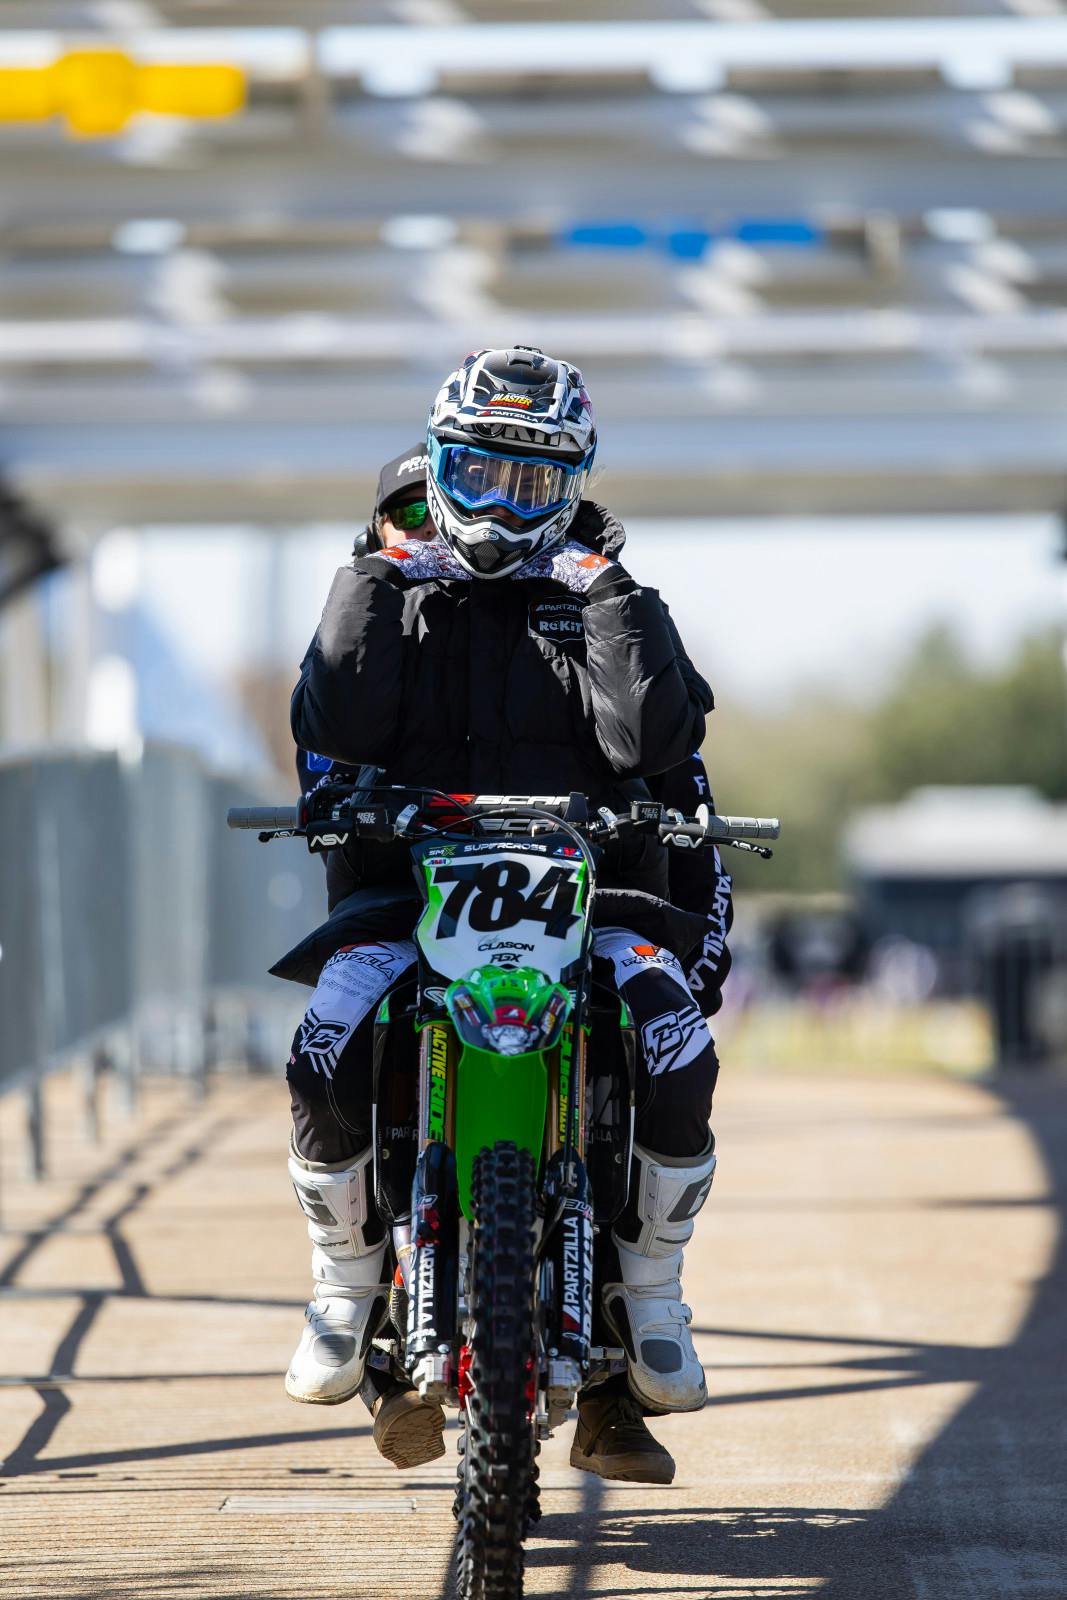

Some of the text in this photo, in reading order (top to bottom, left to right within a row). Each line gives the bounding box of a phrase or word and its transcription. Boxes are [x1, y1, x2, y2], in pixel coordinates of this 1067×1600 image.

[489, 392, 534, 405] BLASTER
[490, 410, 539, 423] PARTZILLA
[544, 603, 583, 614] PARTZILL
[273, 830, 295, 838] ASV
[310, 832, 349, 847] ASV
[662, 832, 703, 849] ASV
[731, 840, 758, 852] ASV
[433, 860, 582, 940] 784
[477, 941, 536, 952] CLASON
[562, 1216, 580, 1304] PARTZILLA
